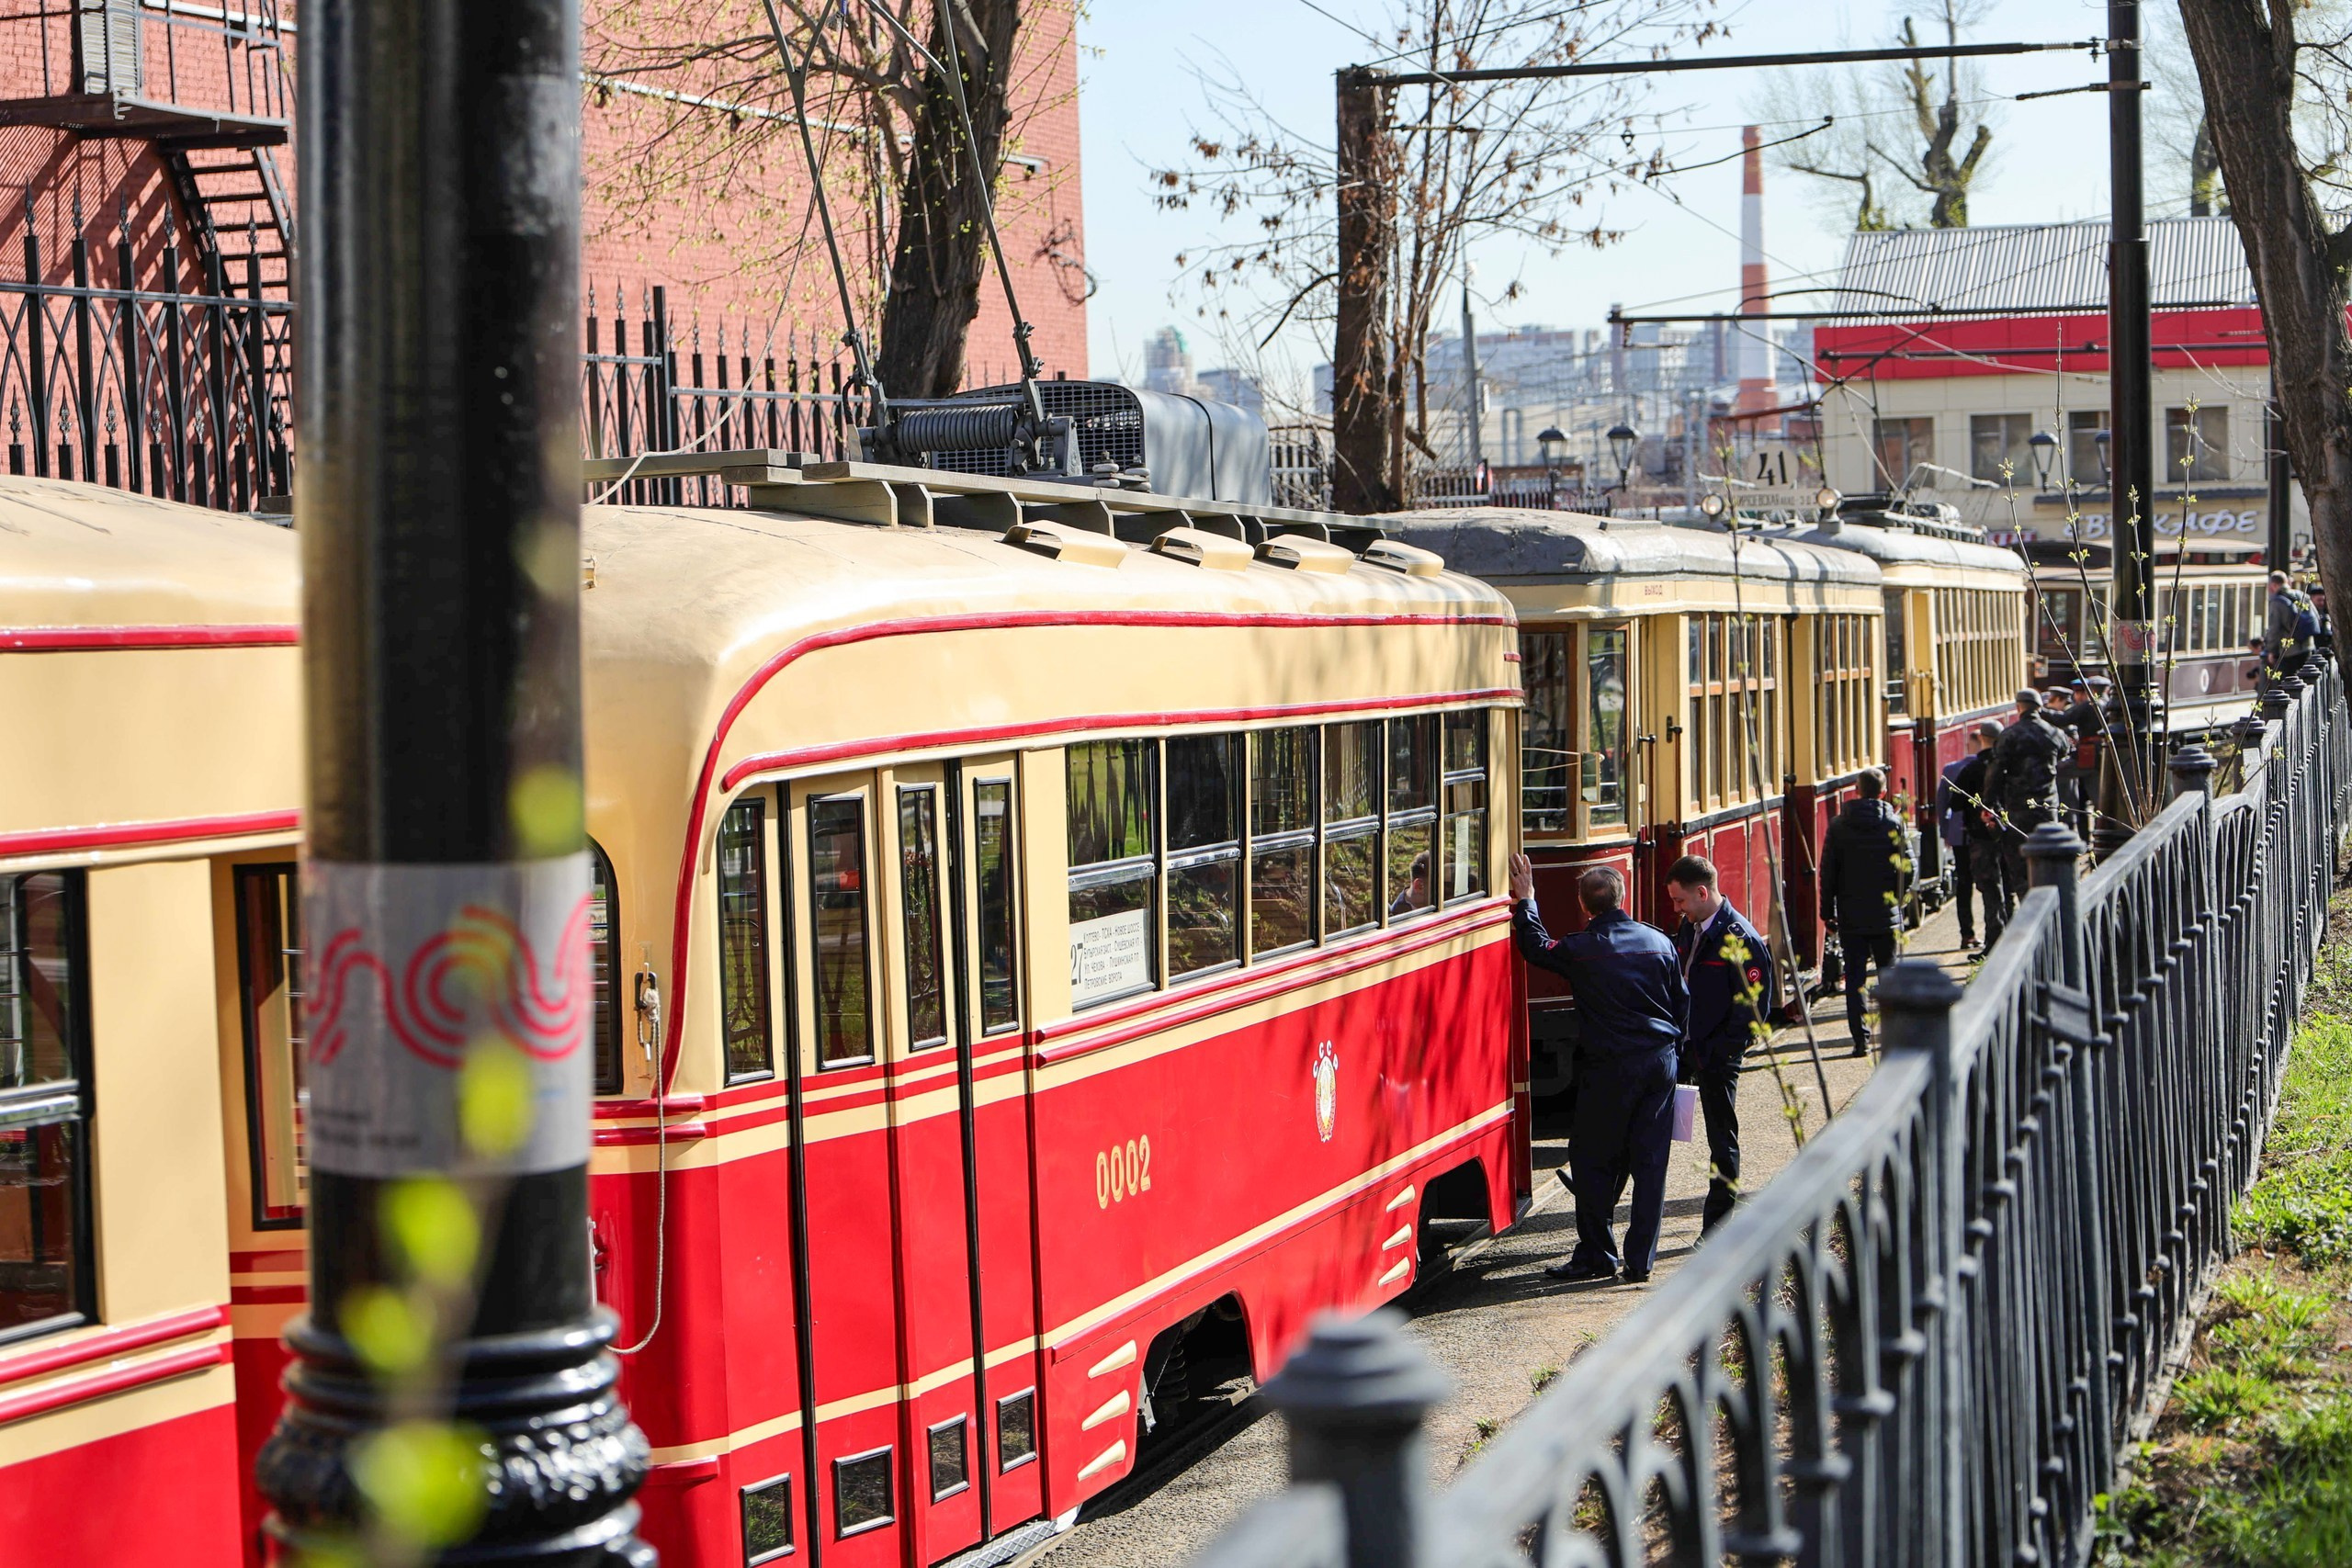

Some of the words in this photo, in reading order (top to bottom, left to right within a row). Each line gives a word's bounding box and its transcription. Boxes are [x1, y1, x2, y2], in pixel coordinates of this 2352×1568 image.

[1757, 450, 1788, 486] 41
[2154, 509, 2259, 536] КАФЕ
[1645, 584, 1663, 595] ВЫХОД
[1071, 943, 1083, 986] 27
[1095, 1134, 1151, 1210] 0002
